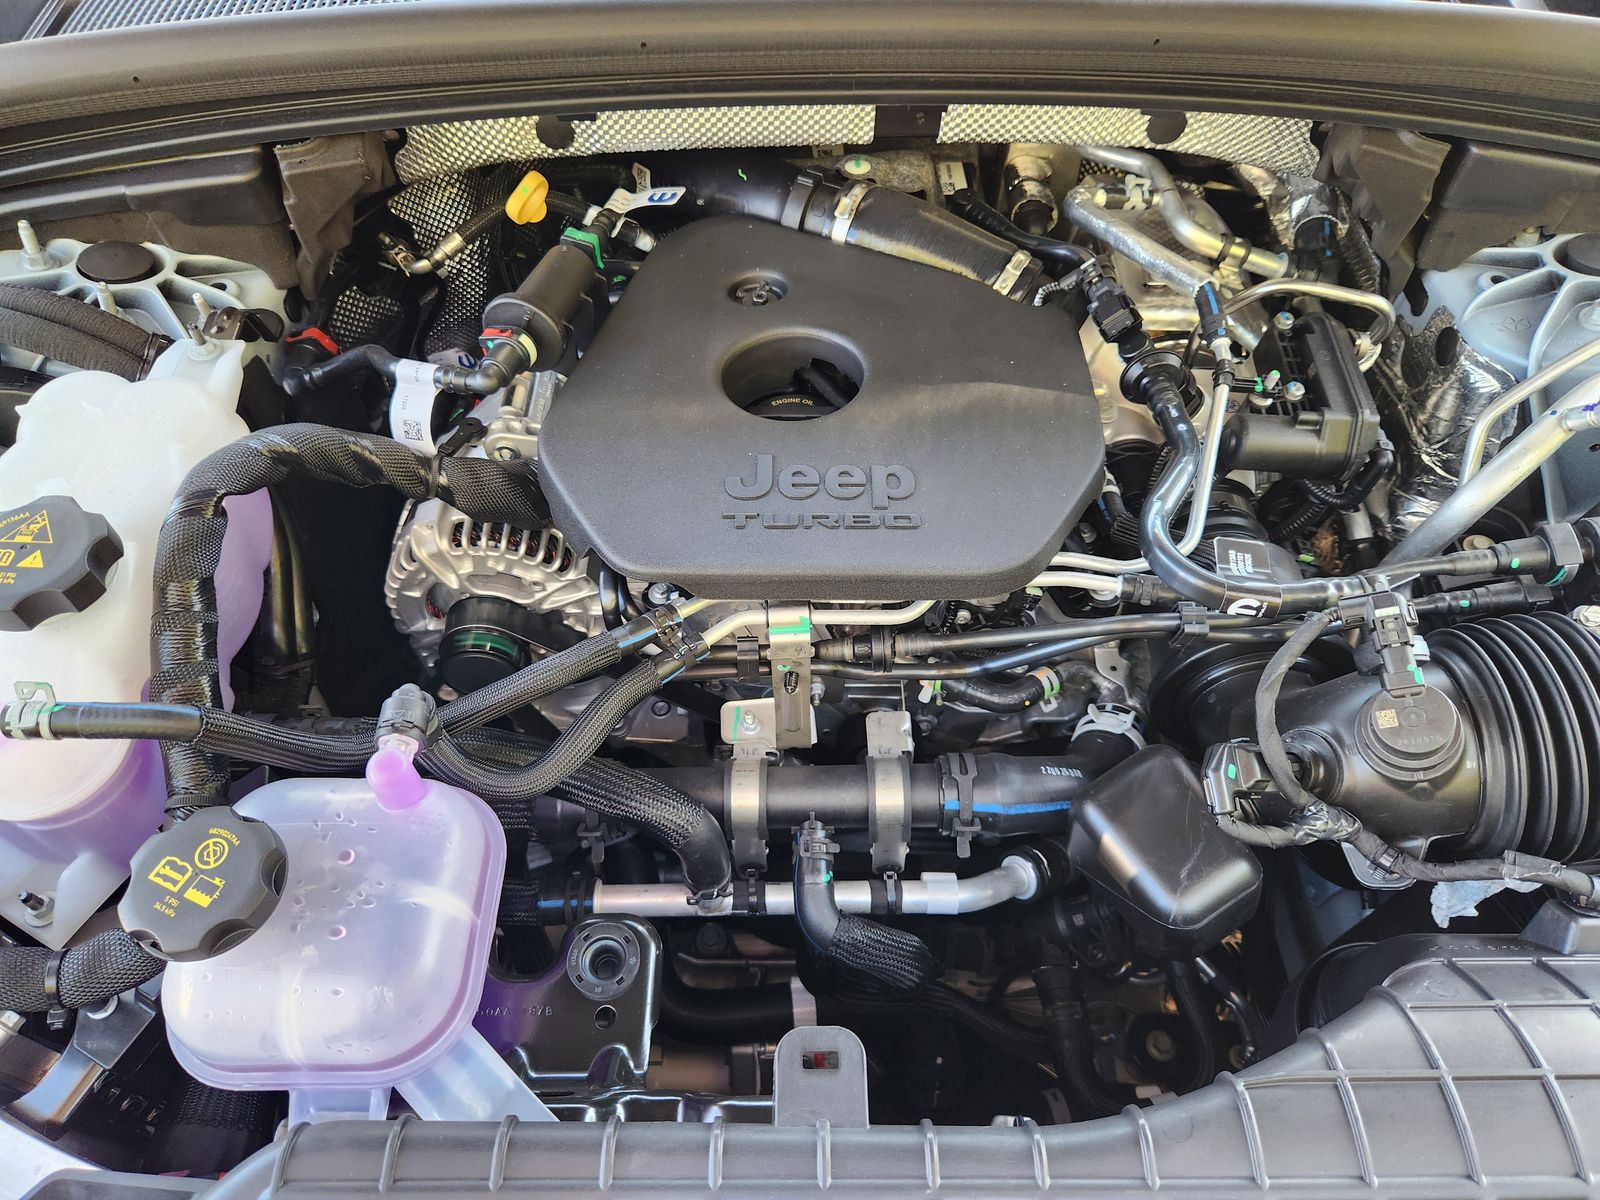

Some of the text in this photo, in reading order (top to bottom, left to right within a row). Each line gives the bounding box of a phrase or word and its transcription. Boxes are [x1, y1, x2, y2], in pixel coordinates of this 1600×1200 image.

[771, 397, 800, 406] ENGINE
[723, 453, 917, 511] Jeep
[721, 511, 923, 530] TURBO
[169, 896, 180, 908] PSI
